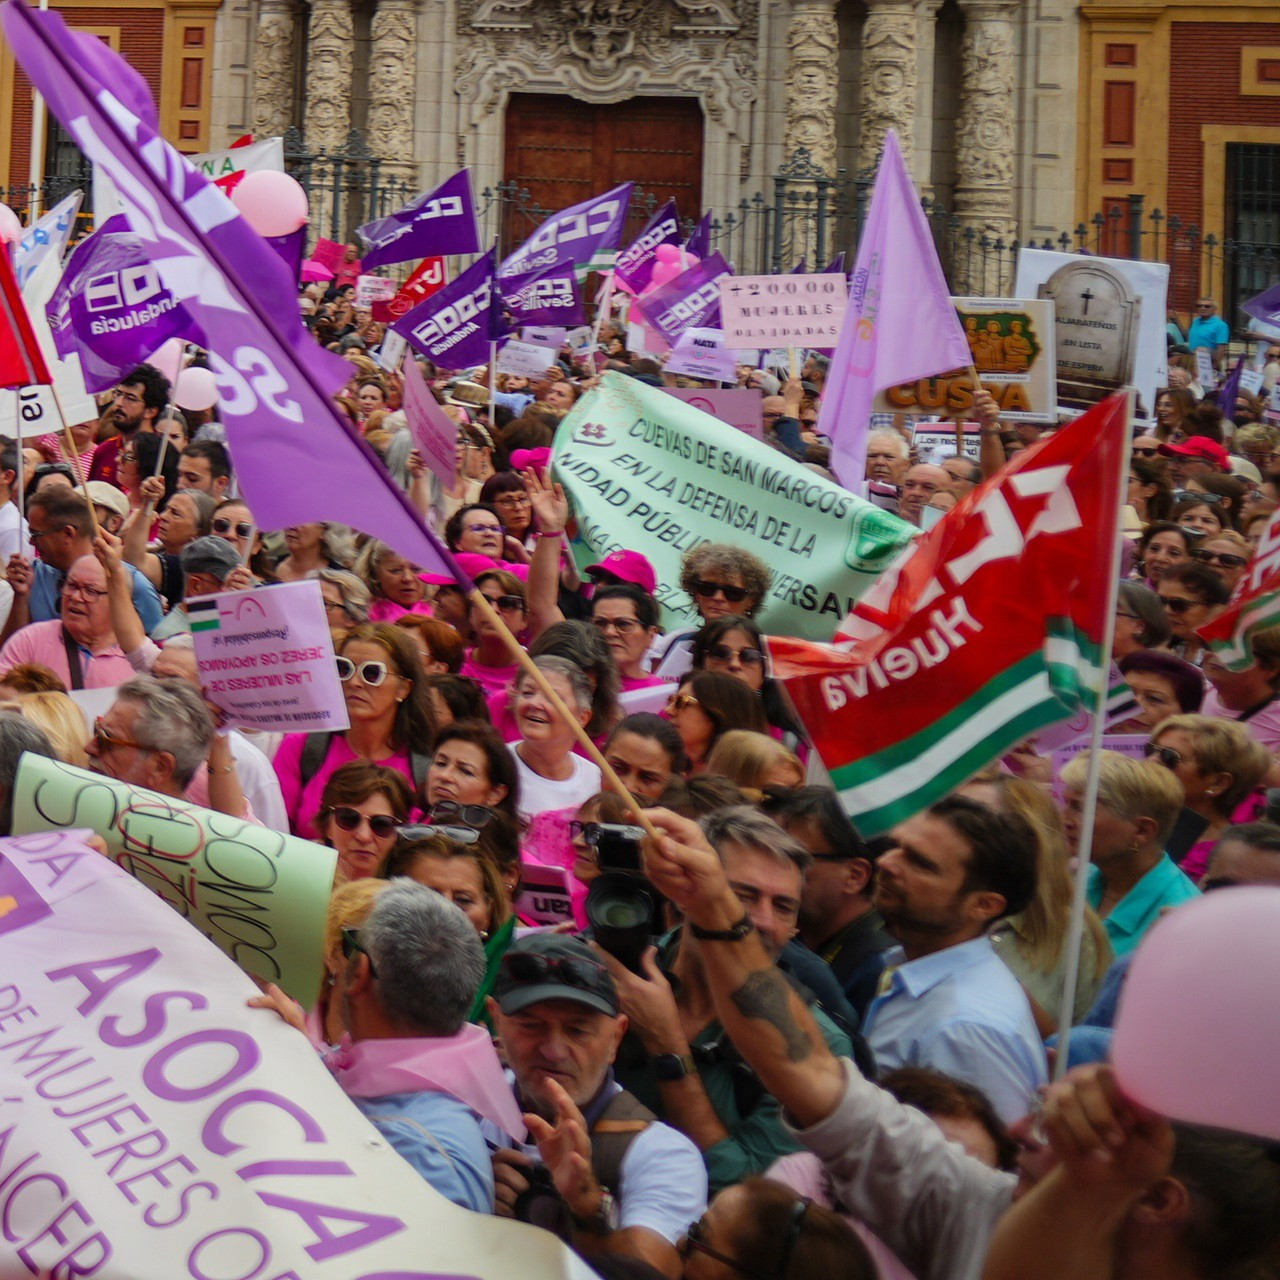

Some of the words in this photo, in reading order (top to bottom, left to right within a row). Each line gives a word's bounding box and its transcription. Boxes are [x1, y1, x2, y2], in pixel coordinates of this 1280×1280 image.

[739, 304, 834, 318] MUJERES
[734, 325, 838, 338] OLVIDADAS
[1063, 338, 1077, 347] EN
[1079, 340, 1103, 351] LISTA
[629, 417, 693, 460] CUEVAS
[696, 440, 718, 470] DE
[719, 450, 760, 486] SAN
[760, 466, 855, 520] MARCOS
[558, 452, 633, 508] NIDAD
[610, 453, 649, 477] EN
[645, 468, 678, 499] LA
[678, 482, 760, 536] DEFENSA
[760, 516, 792, 547] DE
[789, 527, 818, 559] LA
[260, 652, 279, 666] OS
[281, 646, 325, 662] JEREZ
[227, 675, 283, 690] MUJERES
[286, 670, 313, 685] LAS
[533, 894, 572, 916] tan
[45, 946, 409, 1265] ASOCIA
